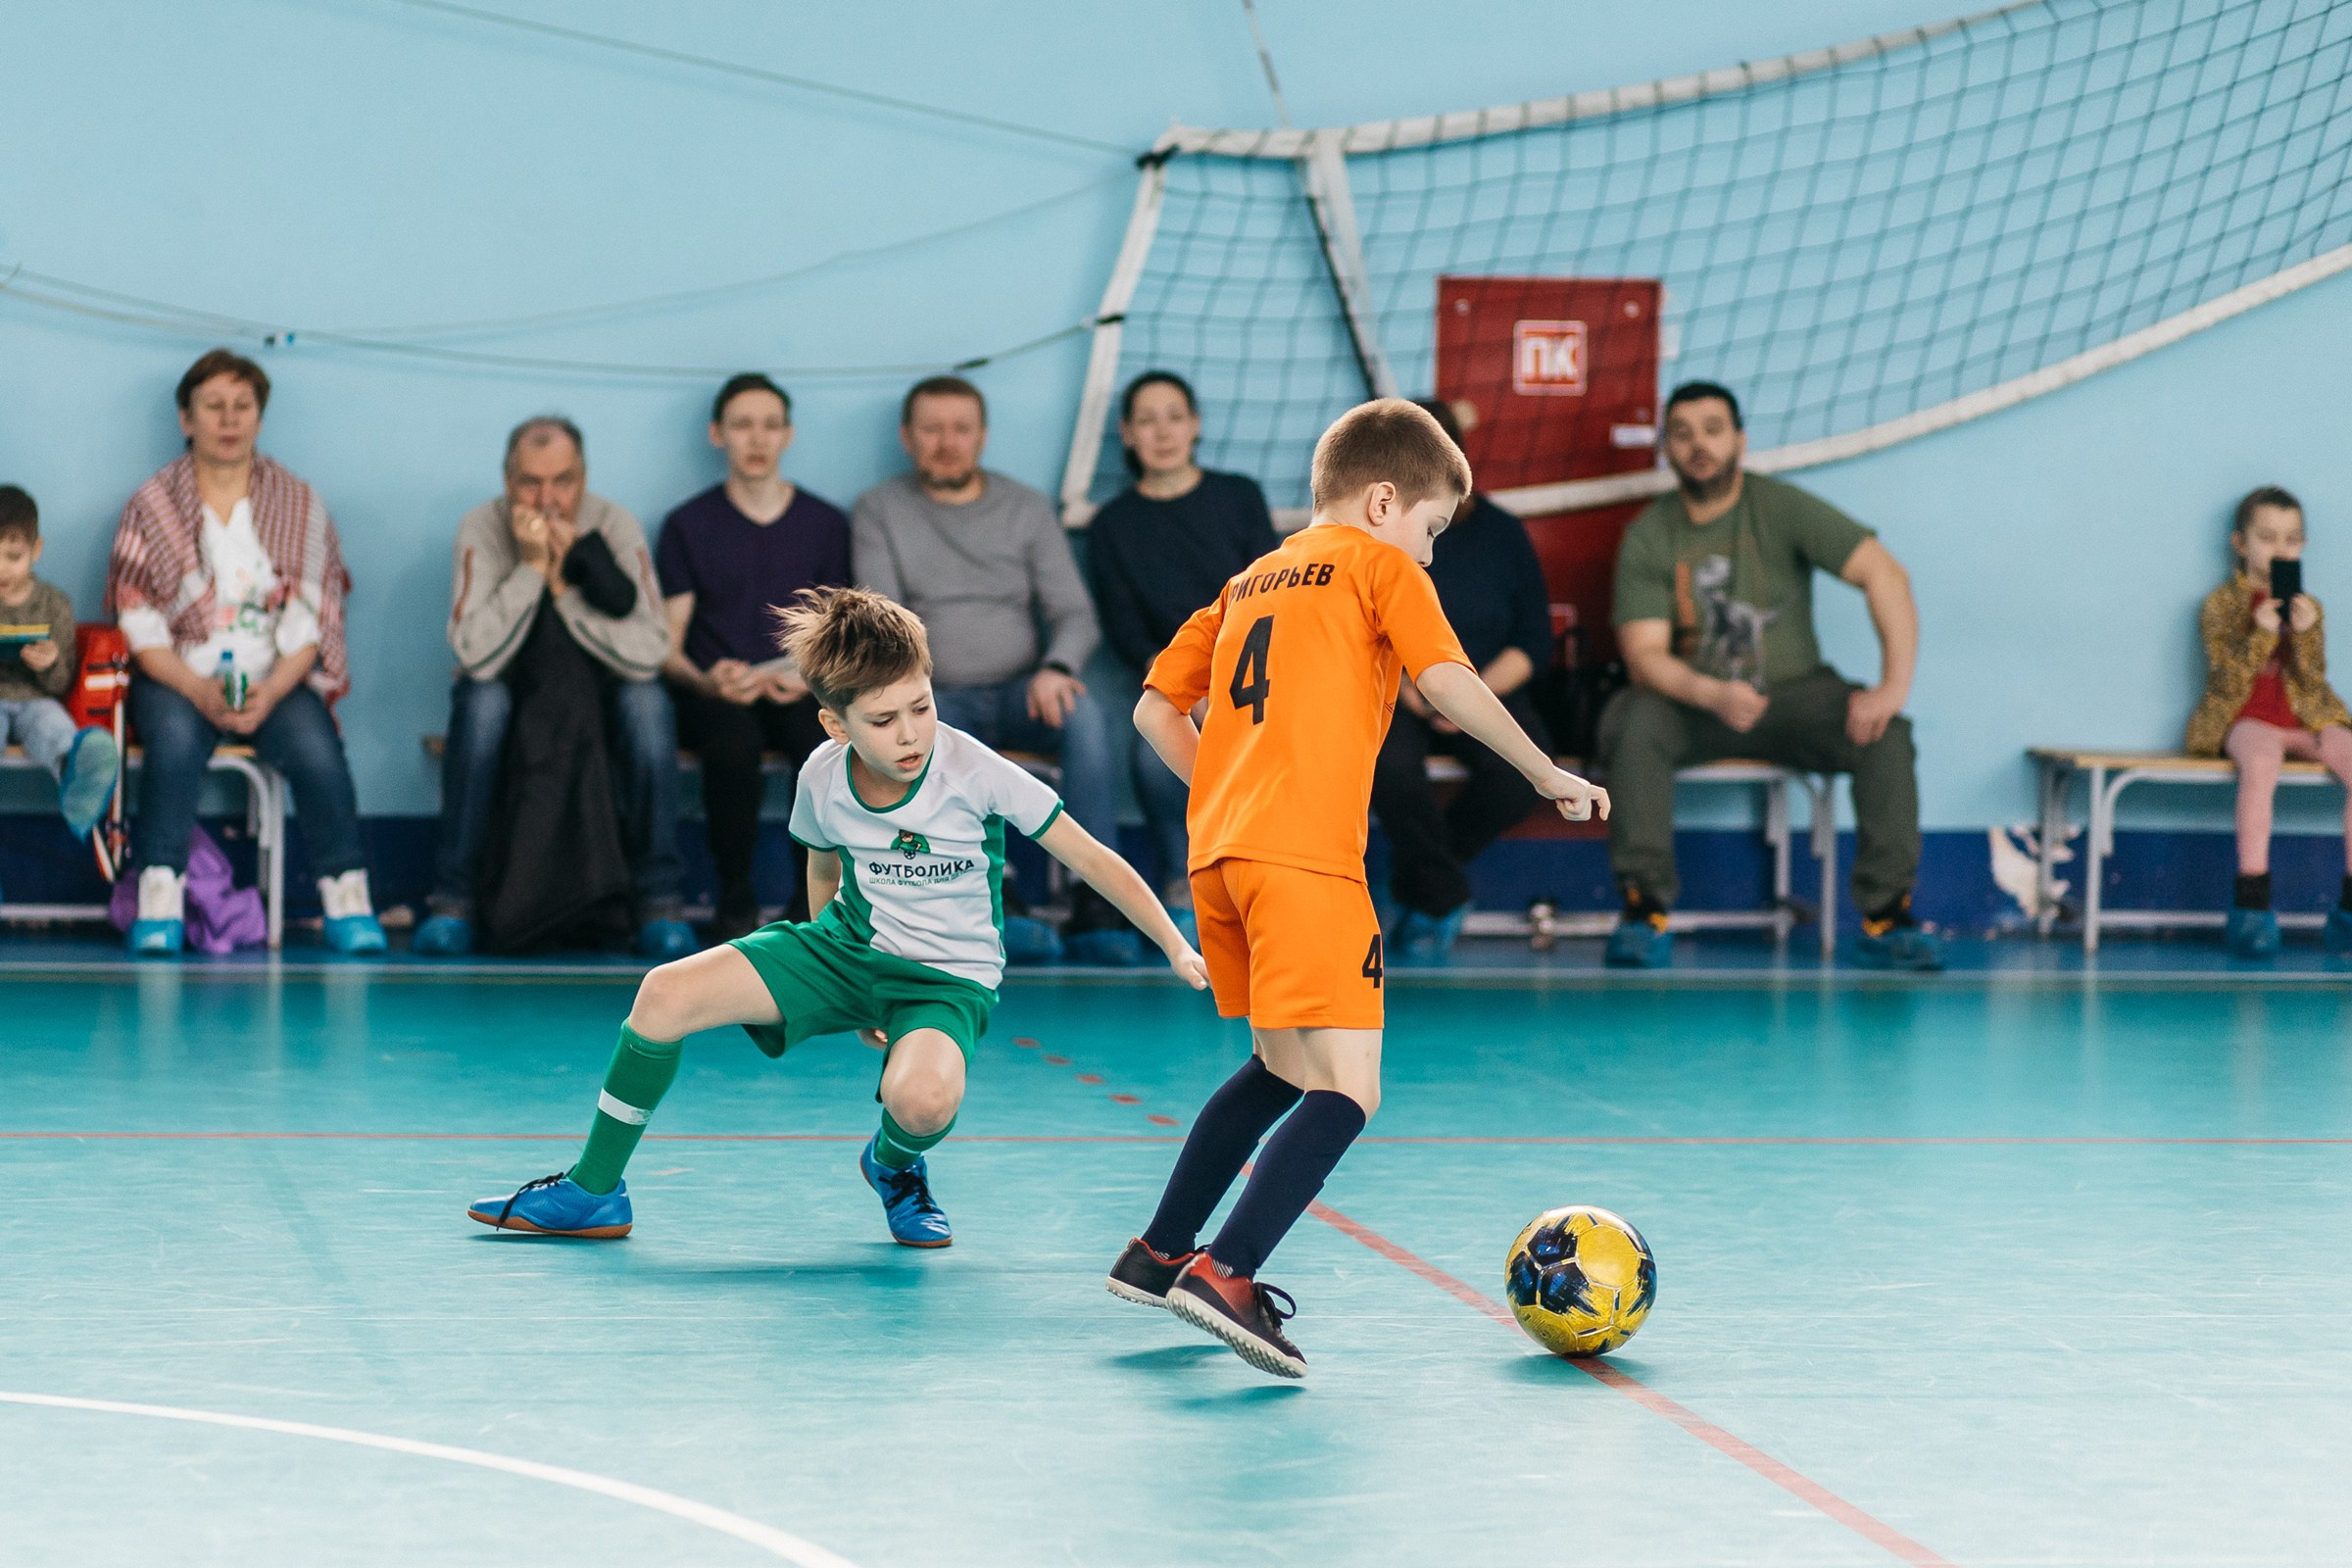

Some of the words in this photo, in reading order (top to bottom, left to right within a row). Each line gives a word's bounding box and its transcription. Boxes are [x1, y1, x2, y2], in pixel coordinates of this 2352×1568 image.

[1521, 334, 1580, 380] ПК
[1228, 564, 1335, 608] РИГОРЬЕВ
[1229, 614, 1274, 725] 4
[869, 859, 974, 878] ФУТБОЛИКА
[869, 877, 896, 886] ШКОЛА
[898, 878, 932, 887] ФУТБОЛА
[1362, 934, 1383, 988] 4
